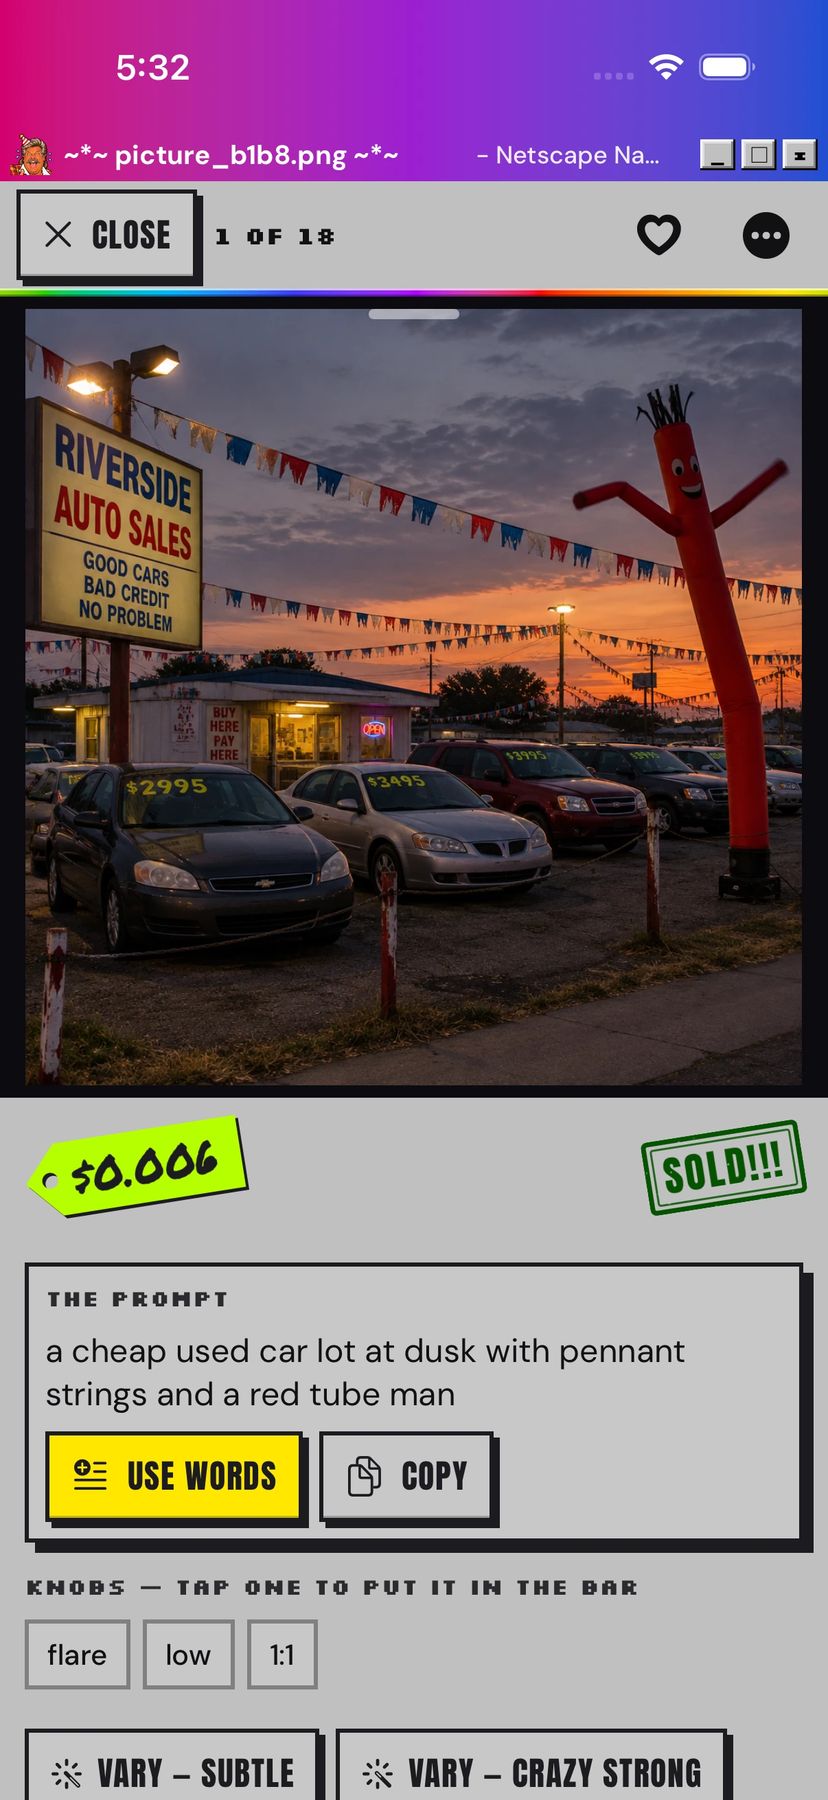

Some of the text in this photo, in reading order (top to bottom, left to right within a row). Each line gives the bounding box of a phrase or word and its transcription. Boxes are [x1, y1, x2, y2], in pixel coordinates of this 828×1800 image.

[117, 54, 189, 81] 5:32
[116, 144, 347, 171] picture_b1b8.png
[497, 145, 607, 170] Netscape
[92, 219, 171, 250] CLOSE
[215, 228, 335, 245] 1 OF 18
[56, 423, 191, 514] RIVERSIDE
[54, 485, 191, 560] AUTO SALES
[84, 551, 169, 587] GOOD CARS
[84, 576, 169, 609] BAD CREDIT
[79, 600, 172, 632] NO PROBLEM
[210, 720, 239, 732] HERE
[213, 707, 236, 718] BUY
[213, 735, 235, 747] PAY
[363, 723, 385, 735] OPEN
[210, 749, 239, 761] HERE
[506, 750, 547, 761] $3995
[126, 778, 208, 795] $2995
[368, 775, 426, 788] $3495
[71, 1140, 218, 1194] $0.006
[662, 1140, 784, 1194] SOLD!!!
[47, 1291, 227, 1307] THE PROMPT
[46, 1337, 686, 1369] a cheap used car lot at dusk with pennant
[46, 1380, 455, 1414] strings and a red tube man
[128, 1460, 276, 1491] USE WORDS
[402, 1460, 468, 1491] COPY
[26, 1579, 125, 1596] KNOBS
[177, 1579, 229, 1596] TAP
[245, 1579, 300, 1596] ONE
[315, 1580, 349, 1596] TO
[363, 1579, 417, 1596] PUT
[431, 1579, 456, 1596] IT
[471, 1580, 501, 1596] IN
[516, 1579, 567, 1596] THE
[582, 1579, 637, 1596] BAR
[47, 1643, 107, 1666] flare
[166, 1643, 211, 1666] low
[270, 1643, 293, 1666] 1:1
[97, 1758, 163, 1788] VARY
[201, 1757, 294, 1788] SUBTLE
[408, 1758, 474, 1788] VARY
[512, 1758, 593, 1788] CRAZY
[603, 1757, 701, 1788] STRONG
